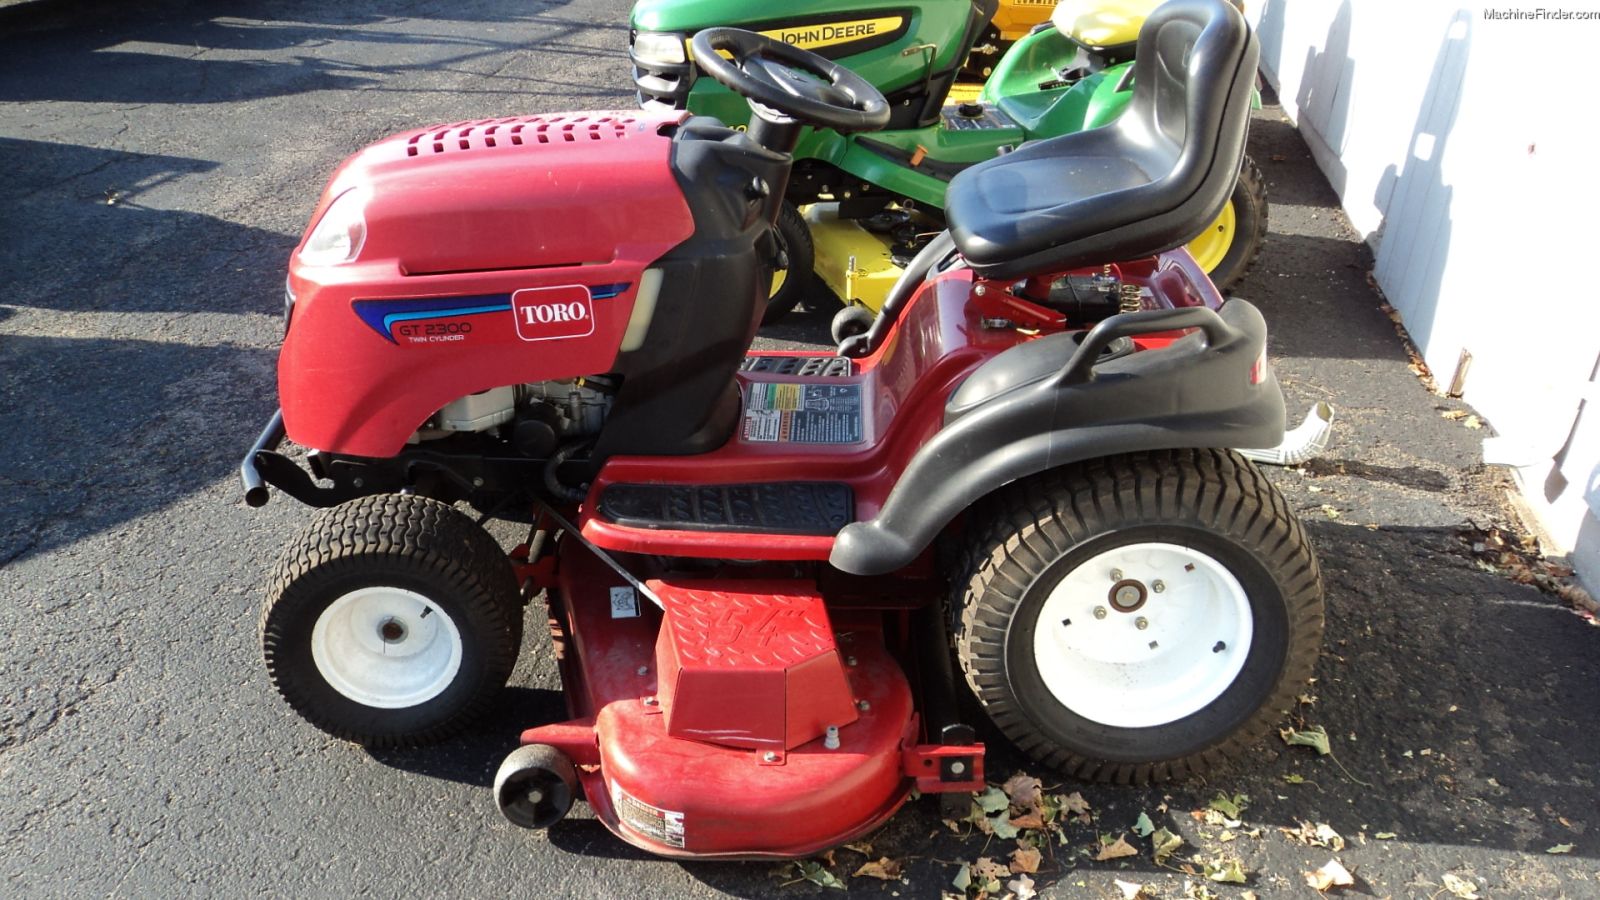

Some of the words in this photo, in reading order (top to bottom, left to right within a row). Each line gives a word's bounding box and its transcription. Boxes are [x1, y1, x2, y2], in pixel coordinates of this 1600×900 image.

[781, 30, 820, 45] JOHN
[822, 23, 876, 41] DEERE
[520, 301, 586, 325] TORO
[399, 324, 420, 336] GT
[424, 322, 472, 335] 2300
[429, 334, 465, 342] CYLINDER
